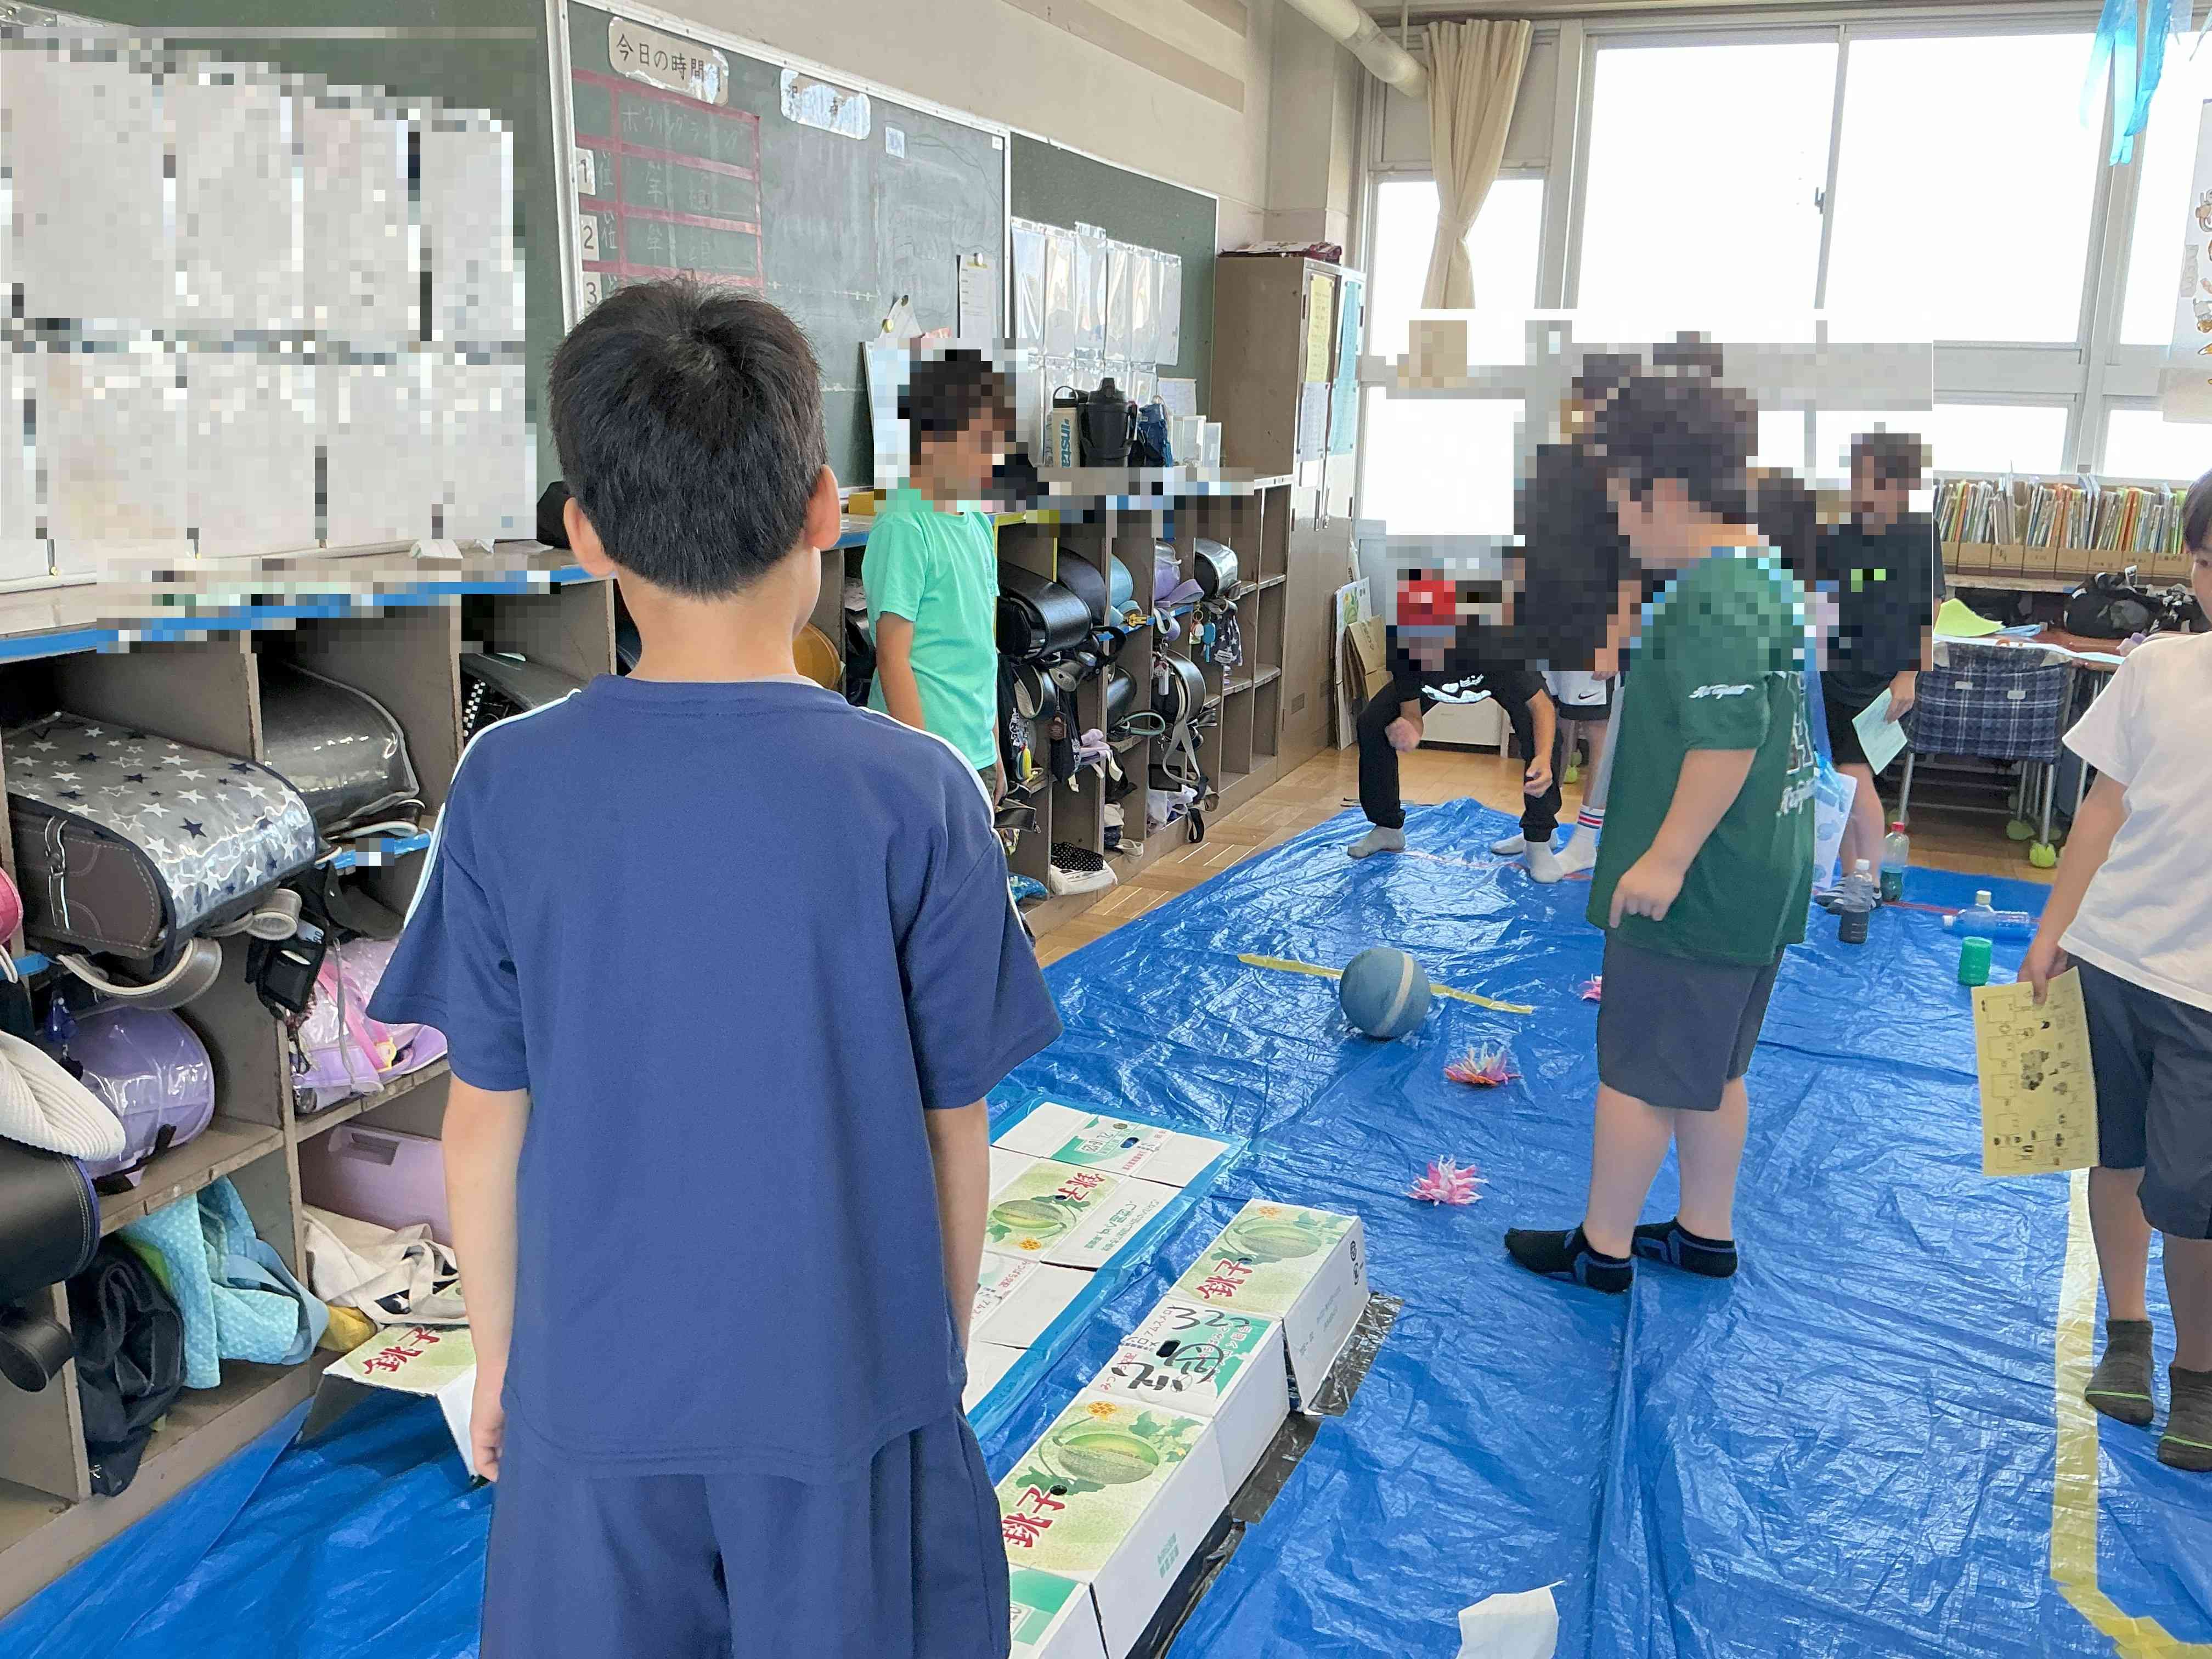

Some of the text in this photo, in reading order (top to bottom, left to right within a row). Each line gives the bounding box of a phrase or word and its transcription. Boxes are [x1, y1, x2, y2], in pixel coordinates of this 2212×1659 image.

[616, 33, 721, 92] 今日の時間
[580, 159, 588, 183] 1
[583, 225, 595, 250] 2
[585, 281, 597, 304] 3
[1058, 1172, 1106, 1201] 銚子
[1195, 1260, 1253, 1299] 銚子
[362, 1327, 440, 1374] 銚子
[1100, 1351, 1137, 1391] みつち交配
[1001, 1487, 1065, 1548] 銚子
